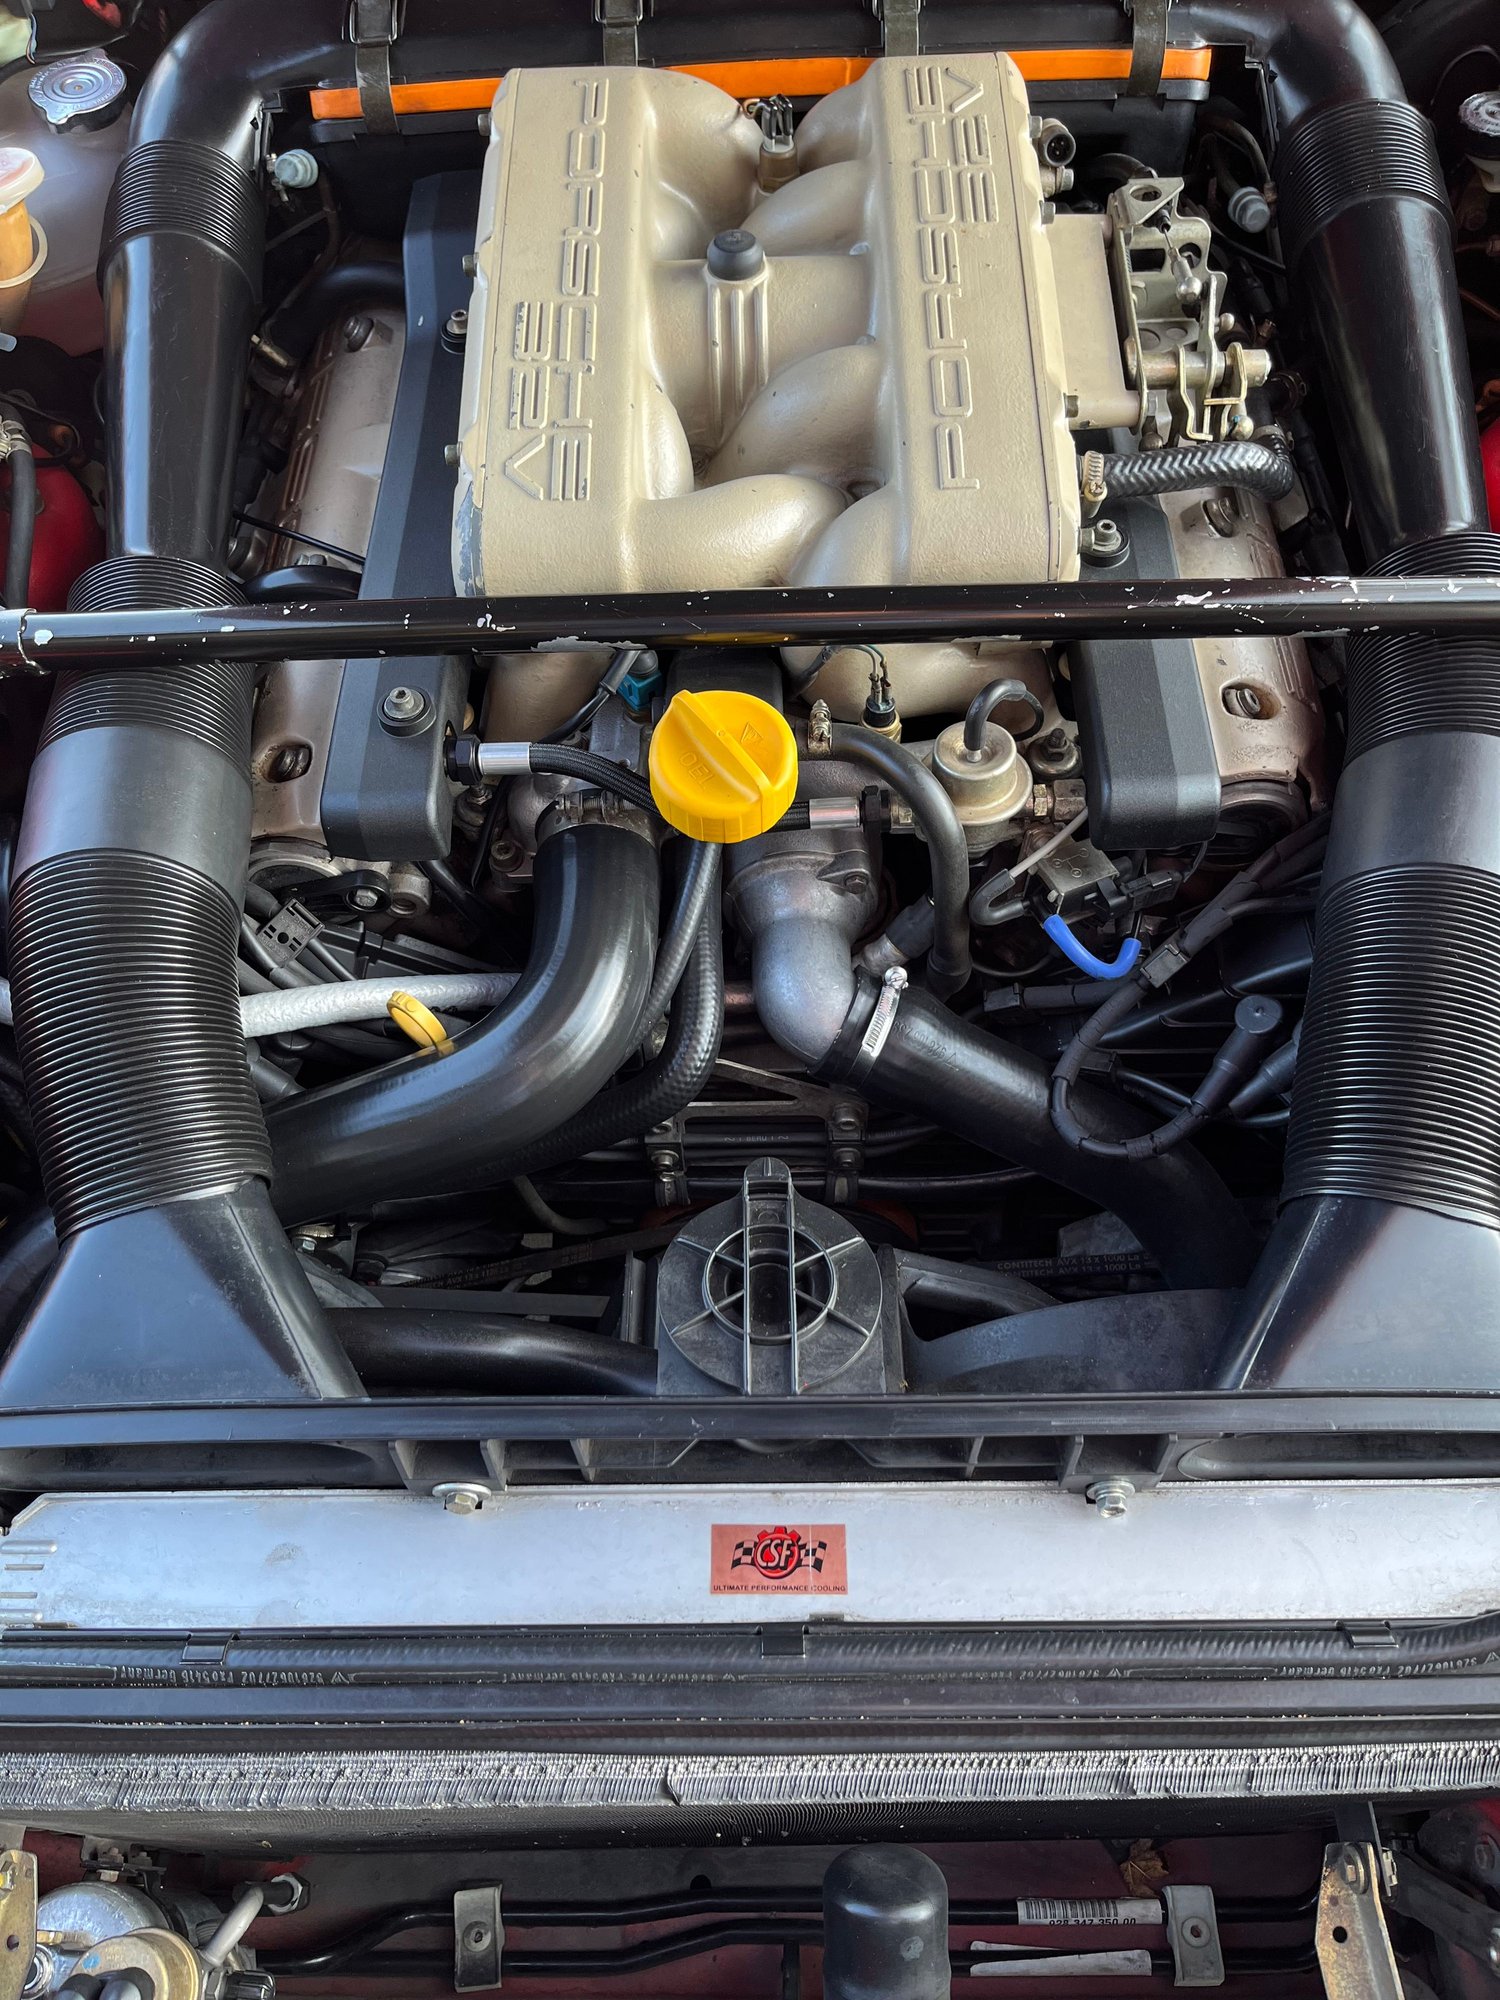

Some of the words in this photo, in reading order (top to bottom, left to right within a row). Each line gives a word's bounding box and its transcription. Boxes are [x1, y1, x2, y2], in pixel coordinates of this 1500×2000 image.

[943, 66, 999, 225] 32V
[550, 76, 610, 501] PORSCHE
[905, 66, 981, 491] PORSCHE
[502, 299, 554, 501] 32V
[997, 1259, 1053, 1271] CONTITECH
[1057, 1256, 1078, 1266] AVX
[713, 1584, 749, 1592] ULTIMATE
[751, 1584, 808, 1592] PERFORMANCE
[811, 1584, 846, 1592] COOLING
[756, 1538, 794, 1569] CSF
[120, 1665, 177, 1683] Germany
